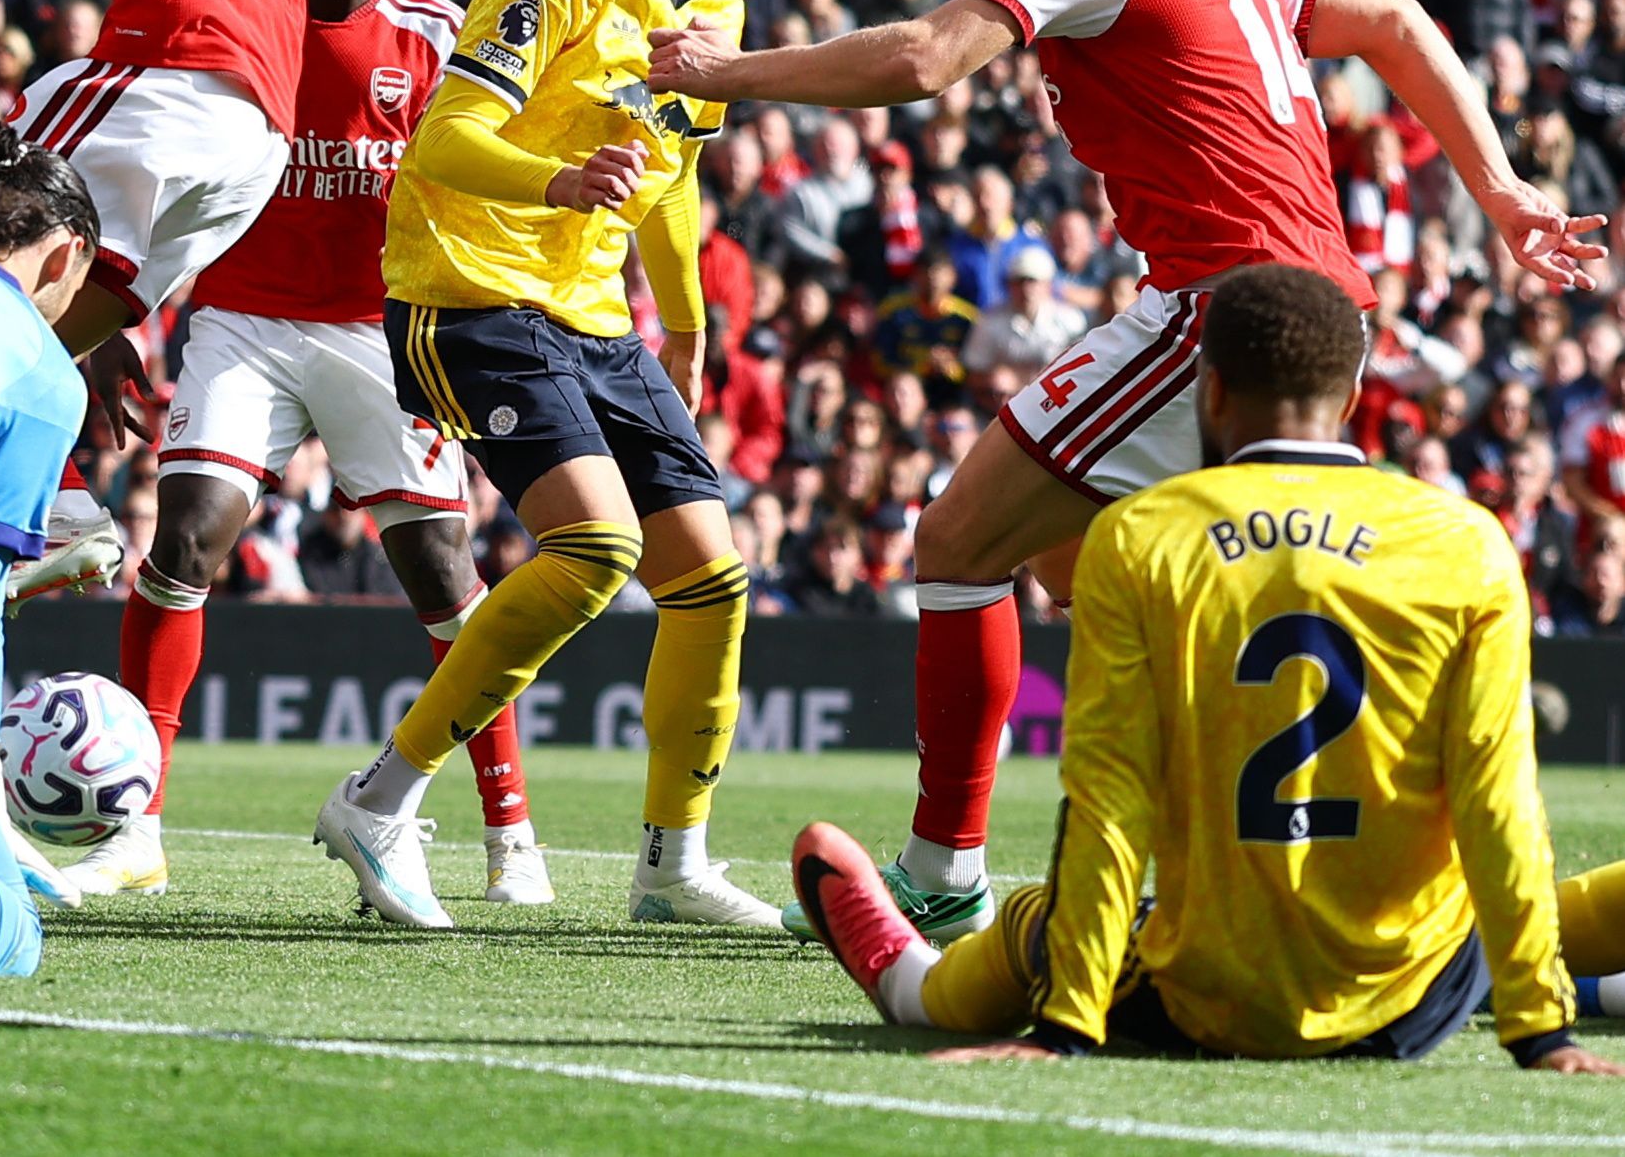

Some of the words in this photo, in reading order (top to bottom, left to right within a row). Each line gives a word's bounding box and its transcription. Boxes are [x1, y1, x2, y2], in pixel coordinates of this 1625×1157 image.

[377, 74, 407, 84] Arsenal
[494, 48, 523, 70] room
[282, 168, 306, 198] LY
[313, 170, 385, 201] BETTER
[412, 417, 445, 472] 7
[1207, 506, 1378, 567] BOGLE
[592, 682, 853, 753] GME
[1233, 612, 1366, 845] 2
